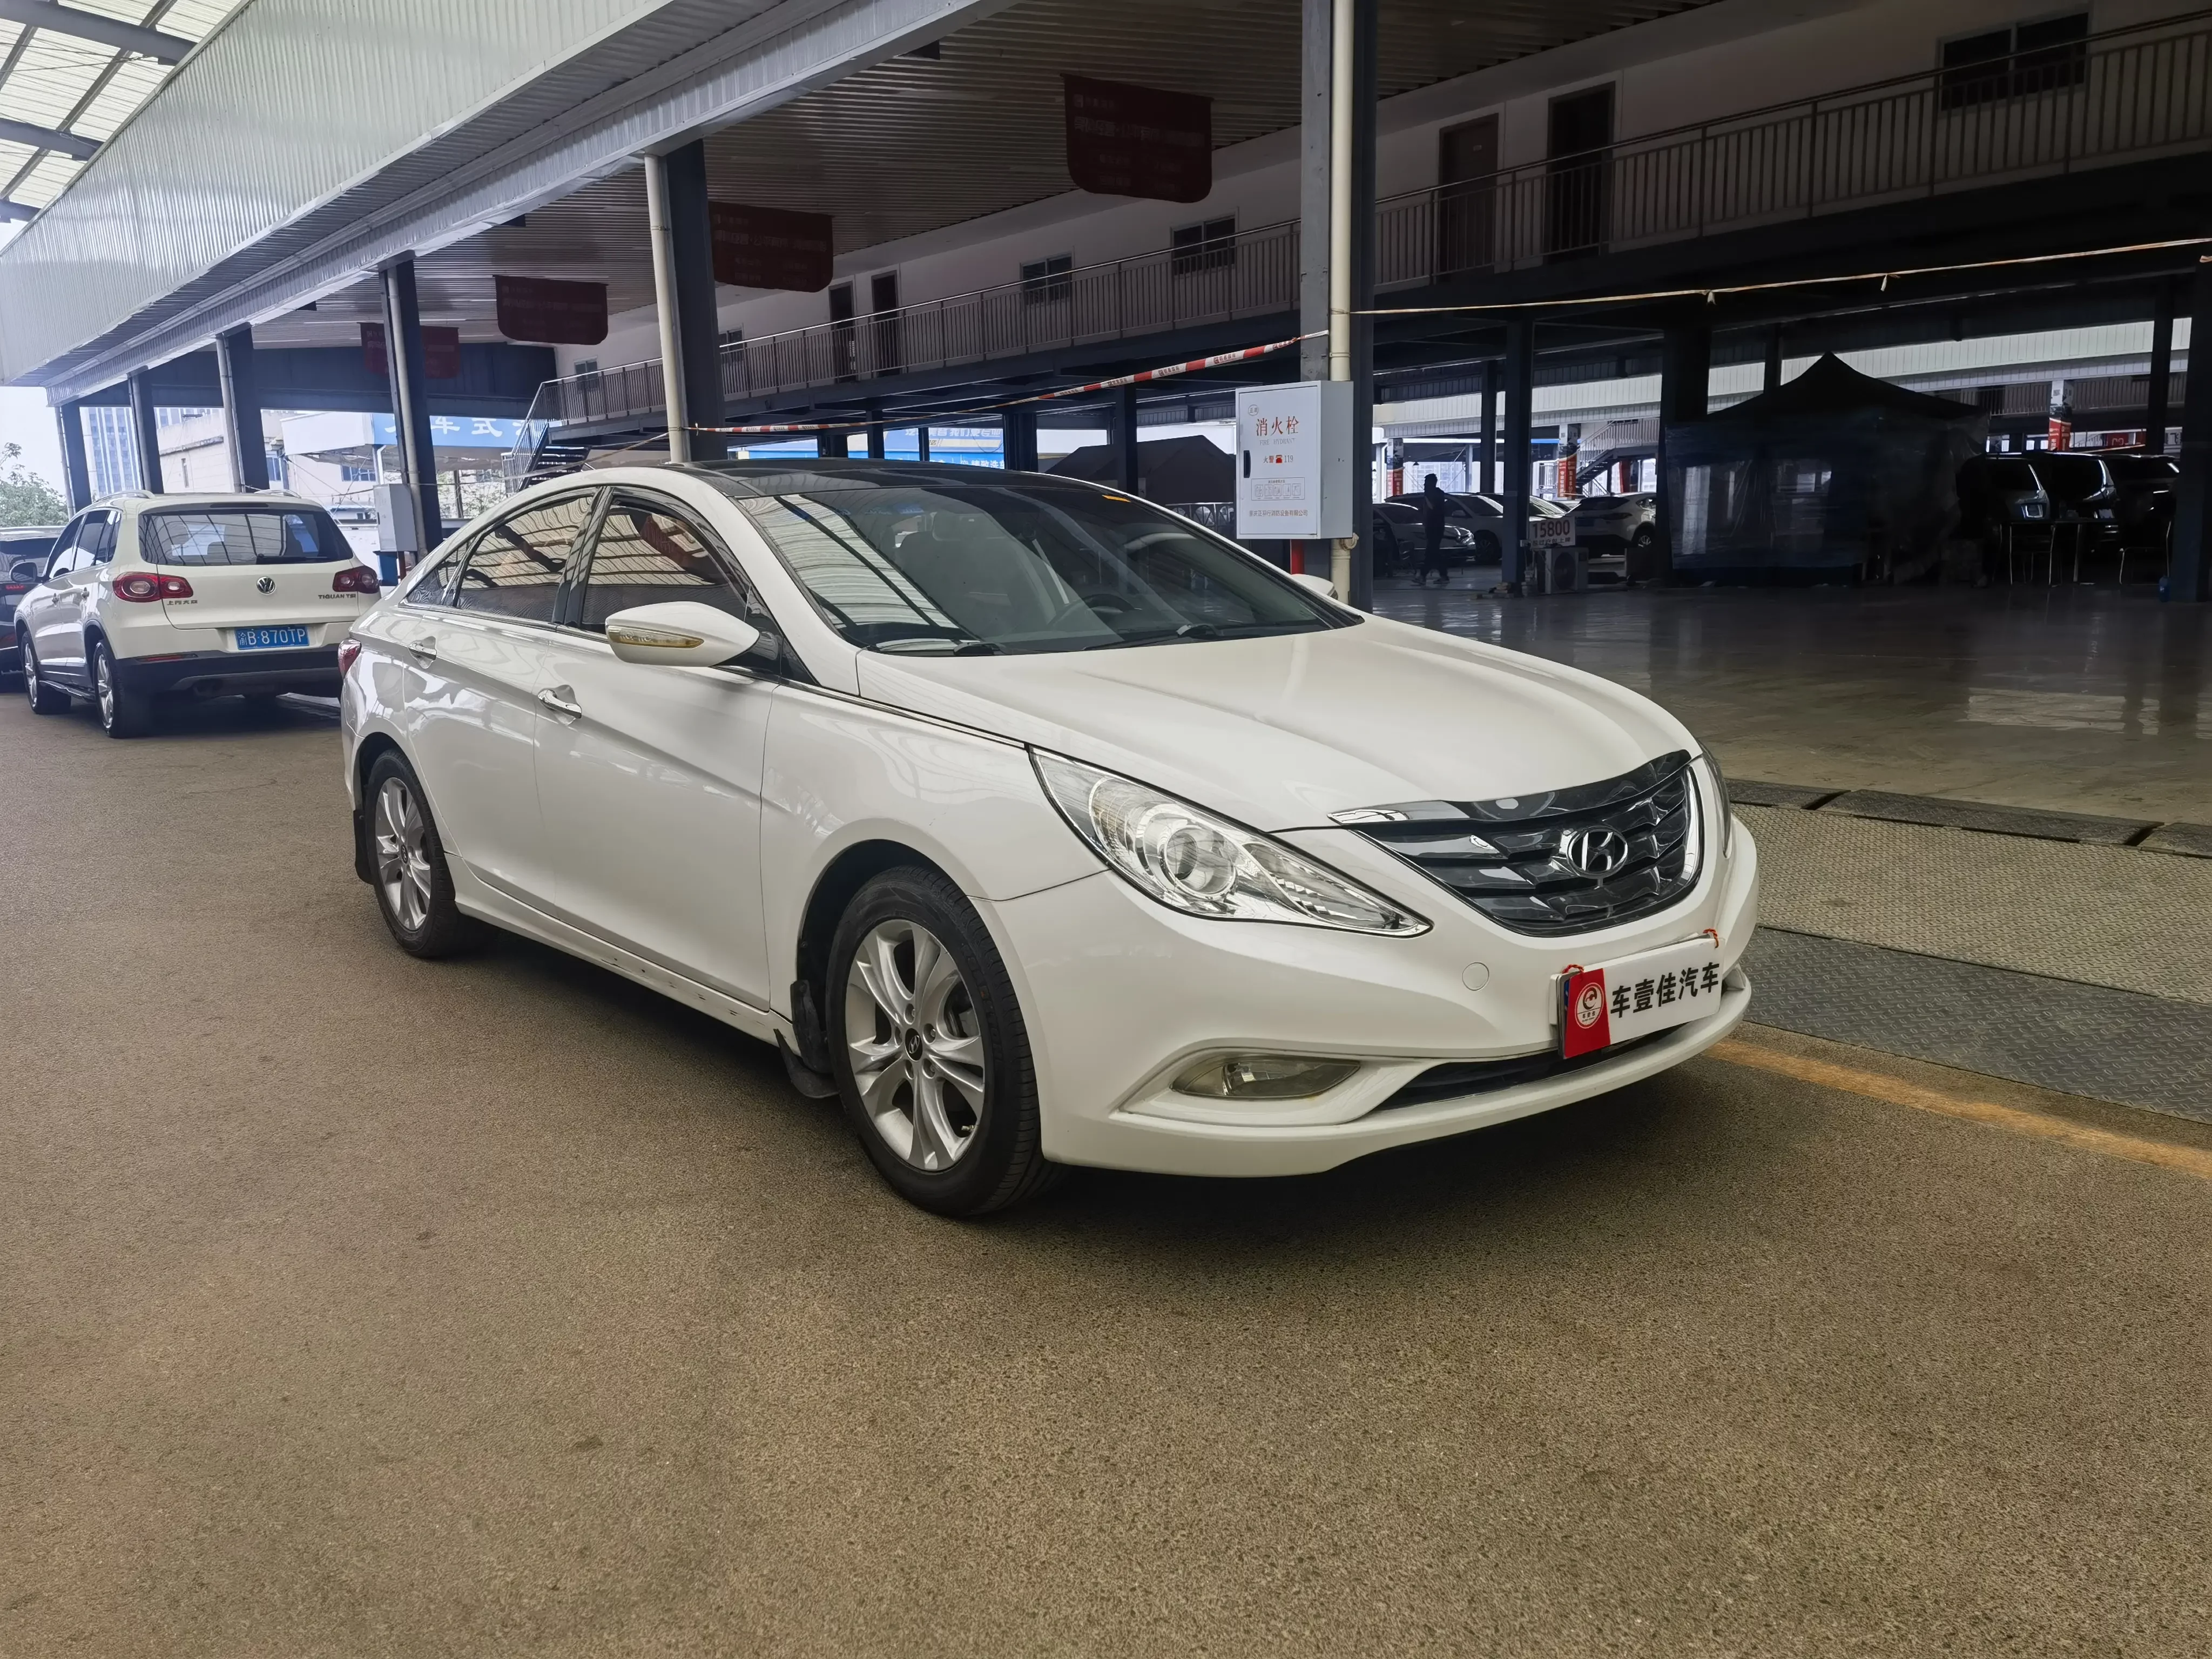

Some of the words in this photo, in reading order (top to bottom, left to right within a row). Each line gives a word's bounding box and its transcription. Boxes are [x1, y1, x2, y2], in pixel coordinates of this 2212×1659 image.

[1256, 416, 1299, 436] 消火栓
[1284, 455, 1293, 463] 119
[1533, 520, 1570, 539] 15800
[1610, 962, 1719, 1018] 车壹佳汽车
